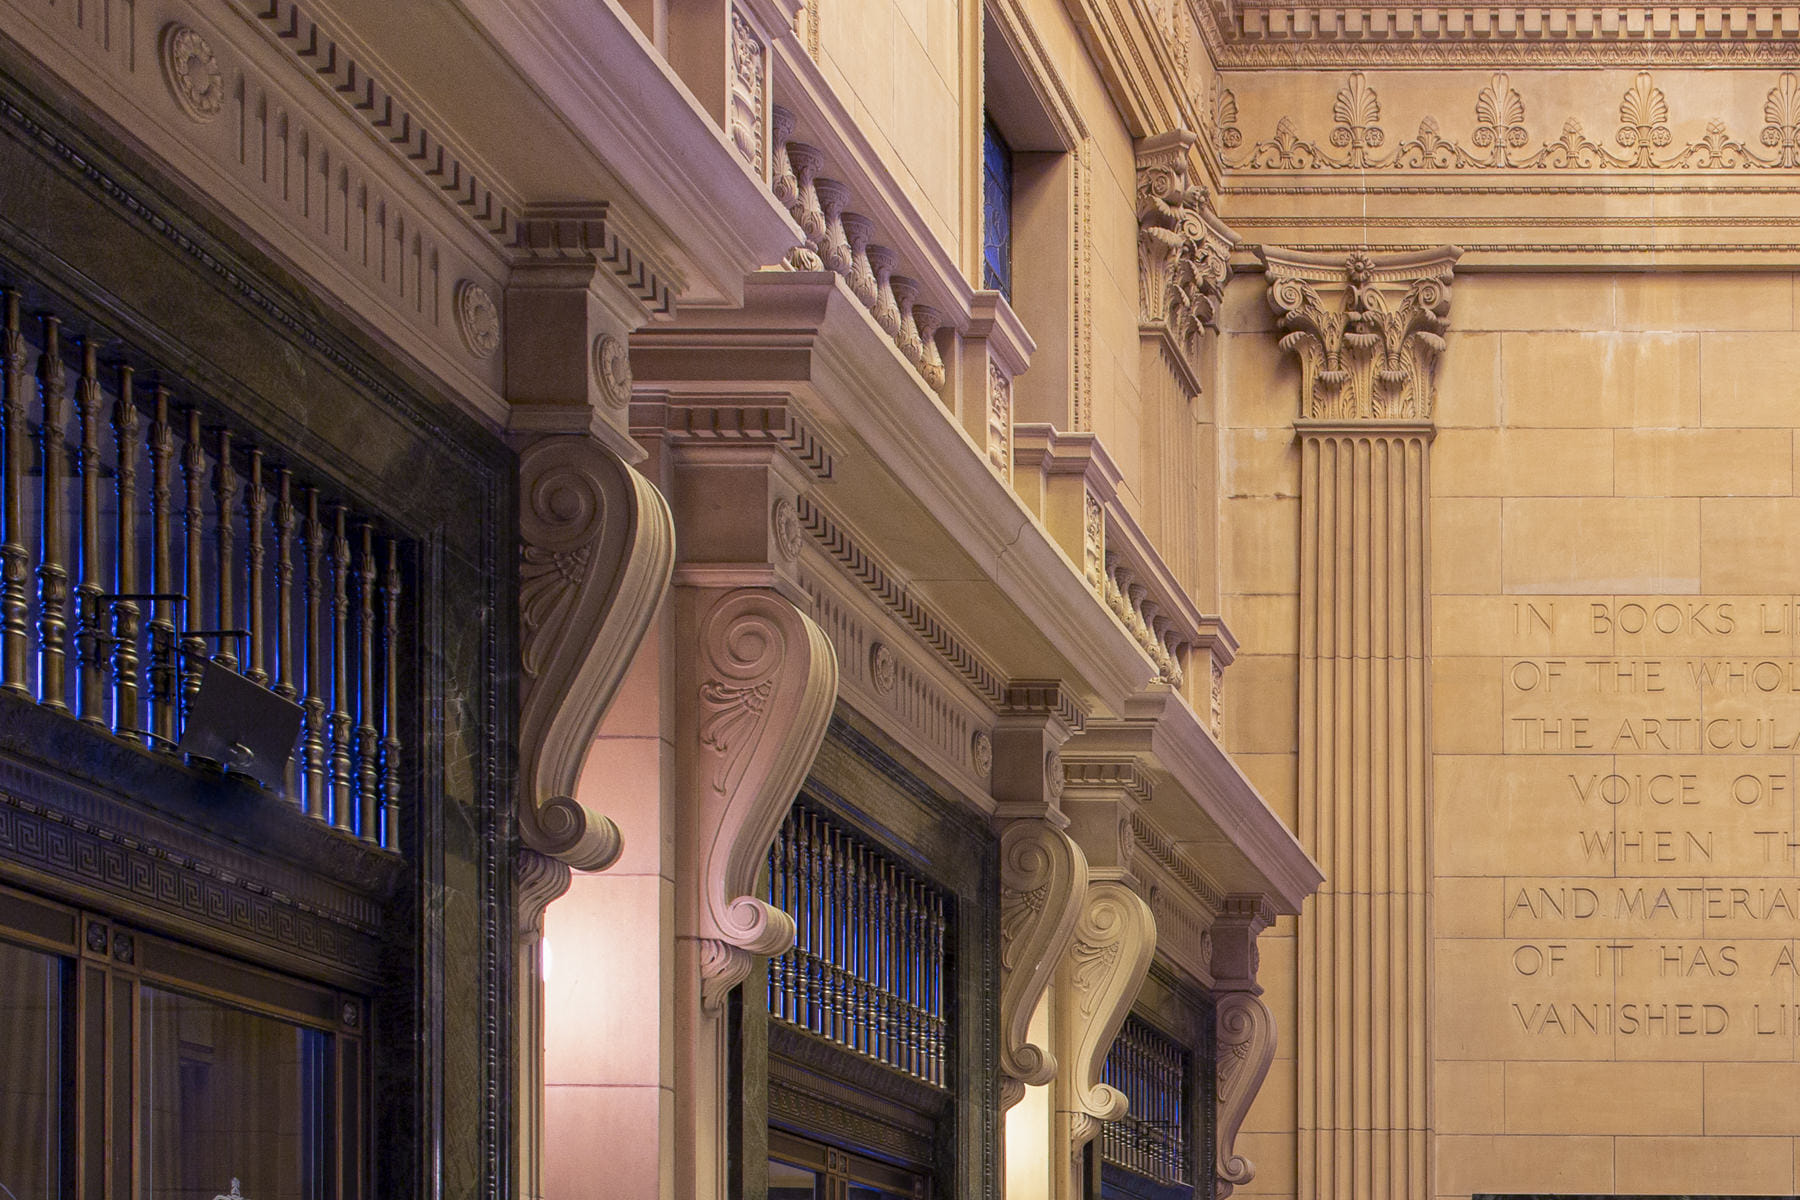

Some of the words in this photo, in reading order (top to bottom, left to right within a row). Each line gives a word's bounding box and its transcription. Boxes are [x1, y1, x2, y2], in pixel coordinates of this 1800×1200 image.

[1513, 603, 1555, 636] IN
[1590, 603, 1737, 636] BOOKS
[1509, 660, 1567, 694] OF
[1584, 660, 1665, 694] THE
[1510, 717, 1594, 751] THE
[1568, 773, 1701, 807] VOICE
[1730, 773, 1787, 807] OF
[1577, 831, 1713, 864] WHEN
[1507, 886, 1600, 921] AND
[1511, 944, 1567, 979] OF
[1593, 944, 1634, 979] IT
[1659, 944, 1740, 979] HAS
[1511, 1002, 1730, 1038] VANISHED
